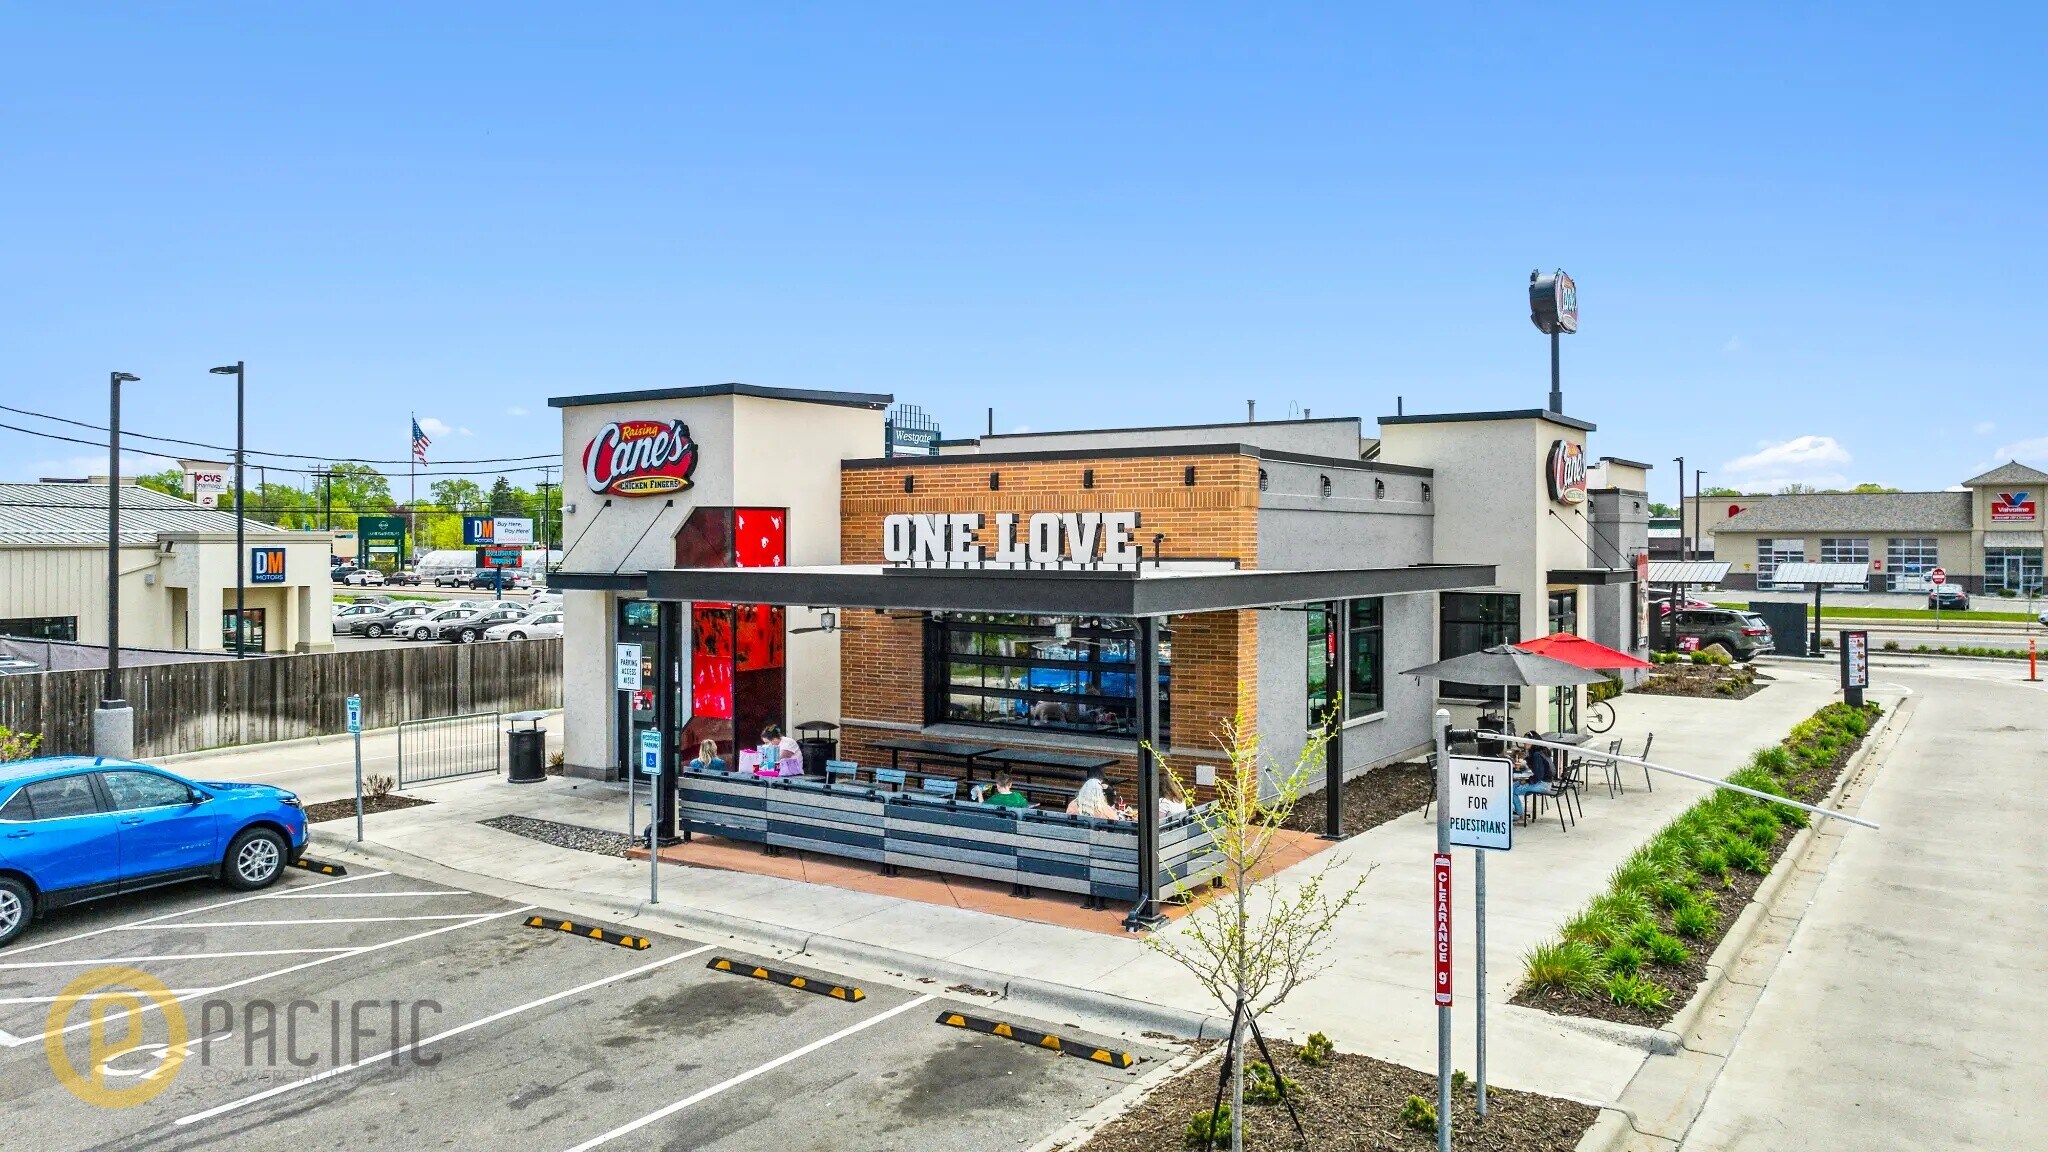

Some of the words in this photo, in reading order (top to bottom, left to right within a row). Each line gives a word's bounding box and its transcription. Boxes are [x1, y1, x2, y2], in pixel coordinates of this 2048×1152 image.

[622, 424, 658, 440] Raising
[896, 430, 932, 444] Westgate
[587, 419, 688, 492] Cane's
[203, 474, 222, 482] CVS
[621, 481, 648, 490] CHICKEN
[650, 479, 679, 489] FINGERS
[474, 520, 493, 538] DM
[884, 514, 986, 562] ONE
[995, 512, 1142, 564] LOVE
[256, 551, 283, 574] DM
[1460, 773, 1494, 787] WATCH
[1468, 796, 1488, 810] FOR
[1450, 817, 1506, 834] PEDESTRIANS
[1437, 872, 1448, 963] CLEARANCE
